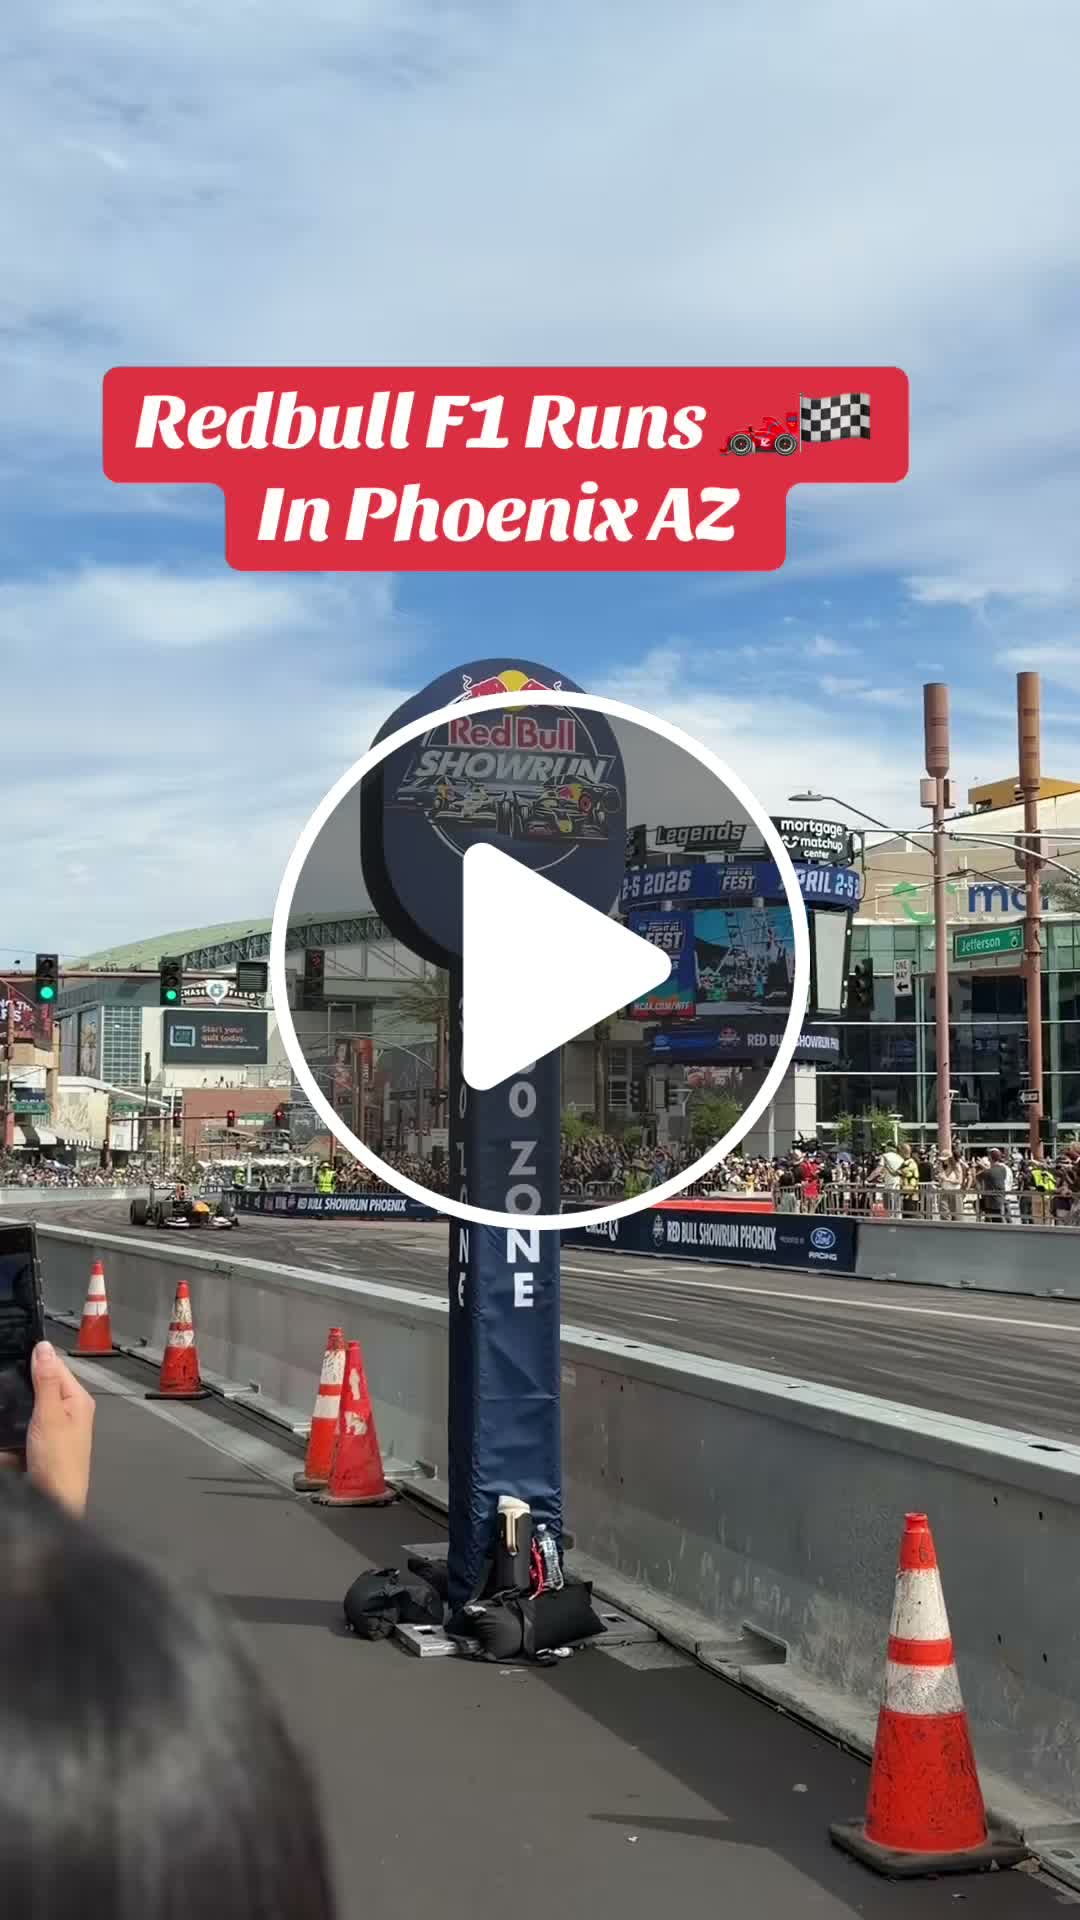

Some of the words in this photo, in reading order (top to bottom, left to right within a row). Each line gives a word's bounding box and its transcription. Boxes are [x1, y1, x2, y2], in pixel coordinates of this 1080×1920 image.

[447, 714, 513, 749] Red
[515, 716, 576, 752] Bull
[414, 750, 607, 785] SHOWRUN
[656, 822, 744, 846] Legends
[781, 820, 843, 838] mortgage
[800, 837, 844, 854] matchup
[803, 850, 830, 859] center
[643, 869, 692, 896] 2026
[722, 875, 755, 891] FEST
[645, 931, 683, 949] FEST
[962, 936, 1001, 953] Jefferson
[324, 1198, 367, 1212] SHOWRUN
[368, 1200, 407, 1212] PHOENIX
[666, 1220, 681, 1243] RED
[681, 1221, 699, 1245] BULL
[699, 1222, 739, 1249] SHOWRUN
[739, 1224, 777, 1251] PHOENIX
[808, 1251, 838, 1261] RACING
